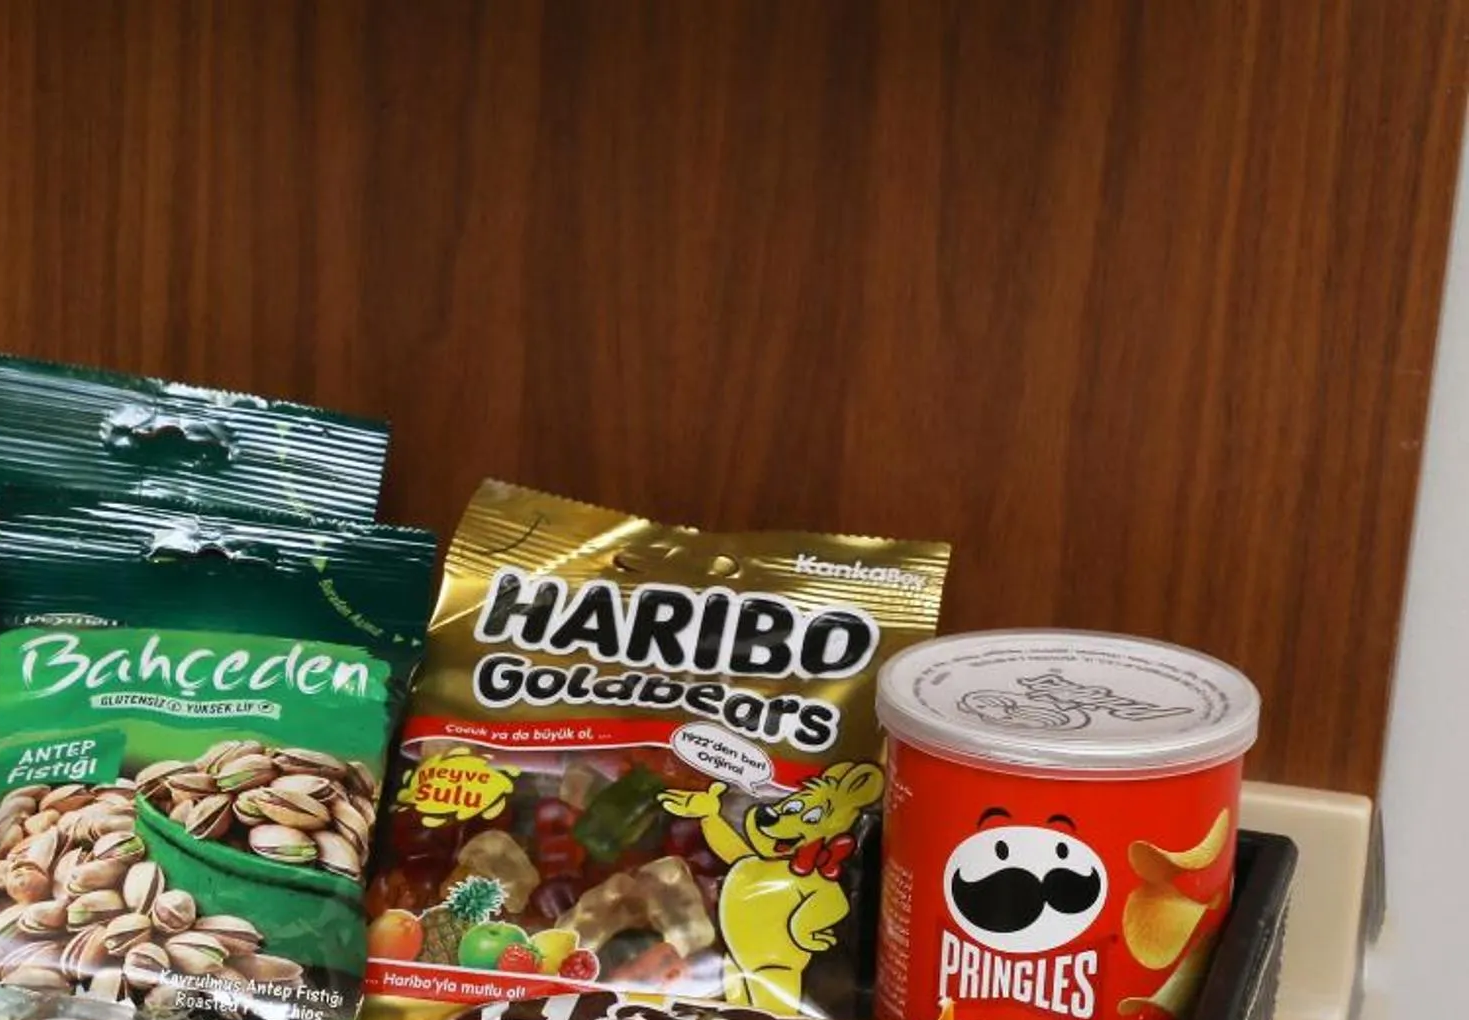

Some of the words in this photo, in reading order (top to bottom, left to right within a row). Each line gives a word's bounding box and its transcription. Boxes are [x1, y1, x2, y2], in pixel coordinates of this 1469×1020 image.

[473, 567, 880, 680] HARIBO
[20, 633, 370, 696] Bahçeden
[473, 650, 842, 752] Goldbears
[490, 729, 508, 741] ya
[511, 728, 530, 741] da
[532, 726, 576, 742] büyük
[18, 739, 96, 767] ANTEP
[418, 767, 491, 787] Meyve
[415, 785, 484, 809] Sulu
[382, 970, 459, 998] Haribo'yla
[461, 979, 503, 997] mutlu
[939, 930, 1097, 1020] PRINGLES
[175, 990, 238, 1013] Roasted
[246, 978, 293, 1001] Antep
